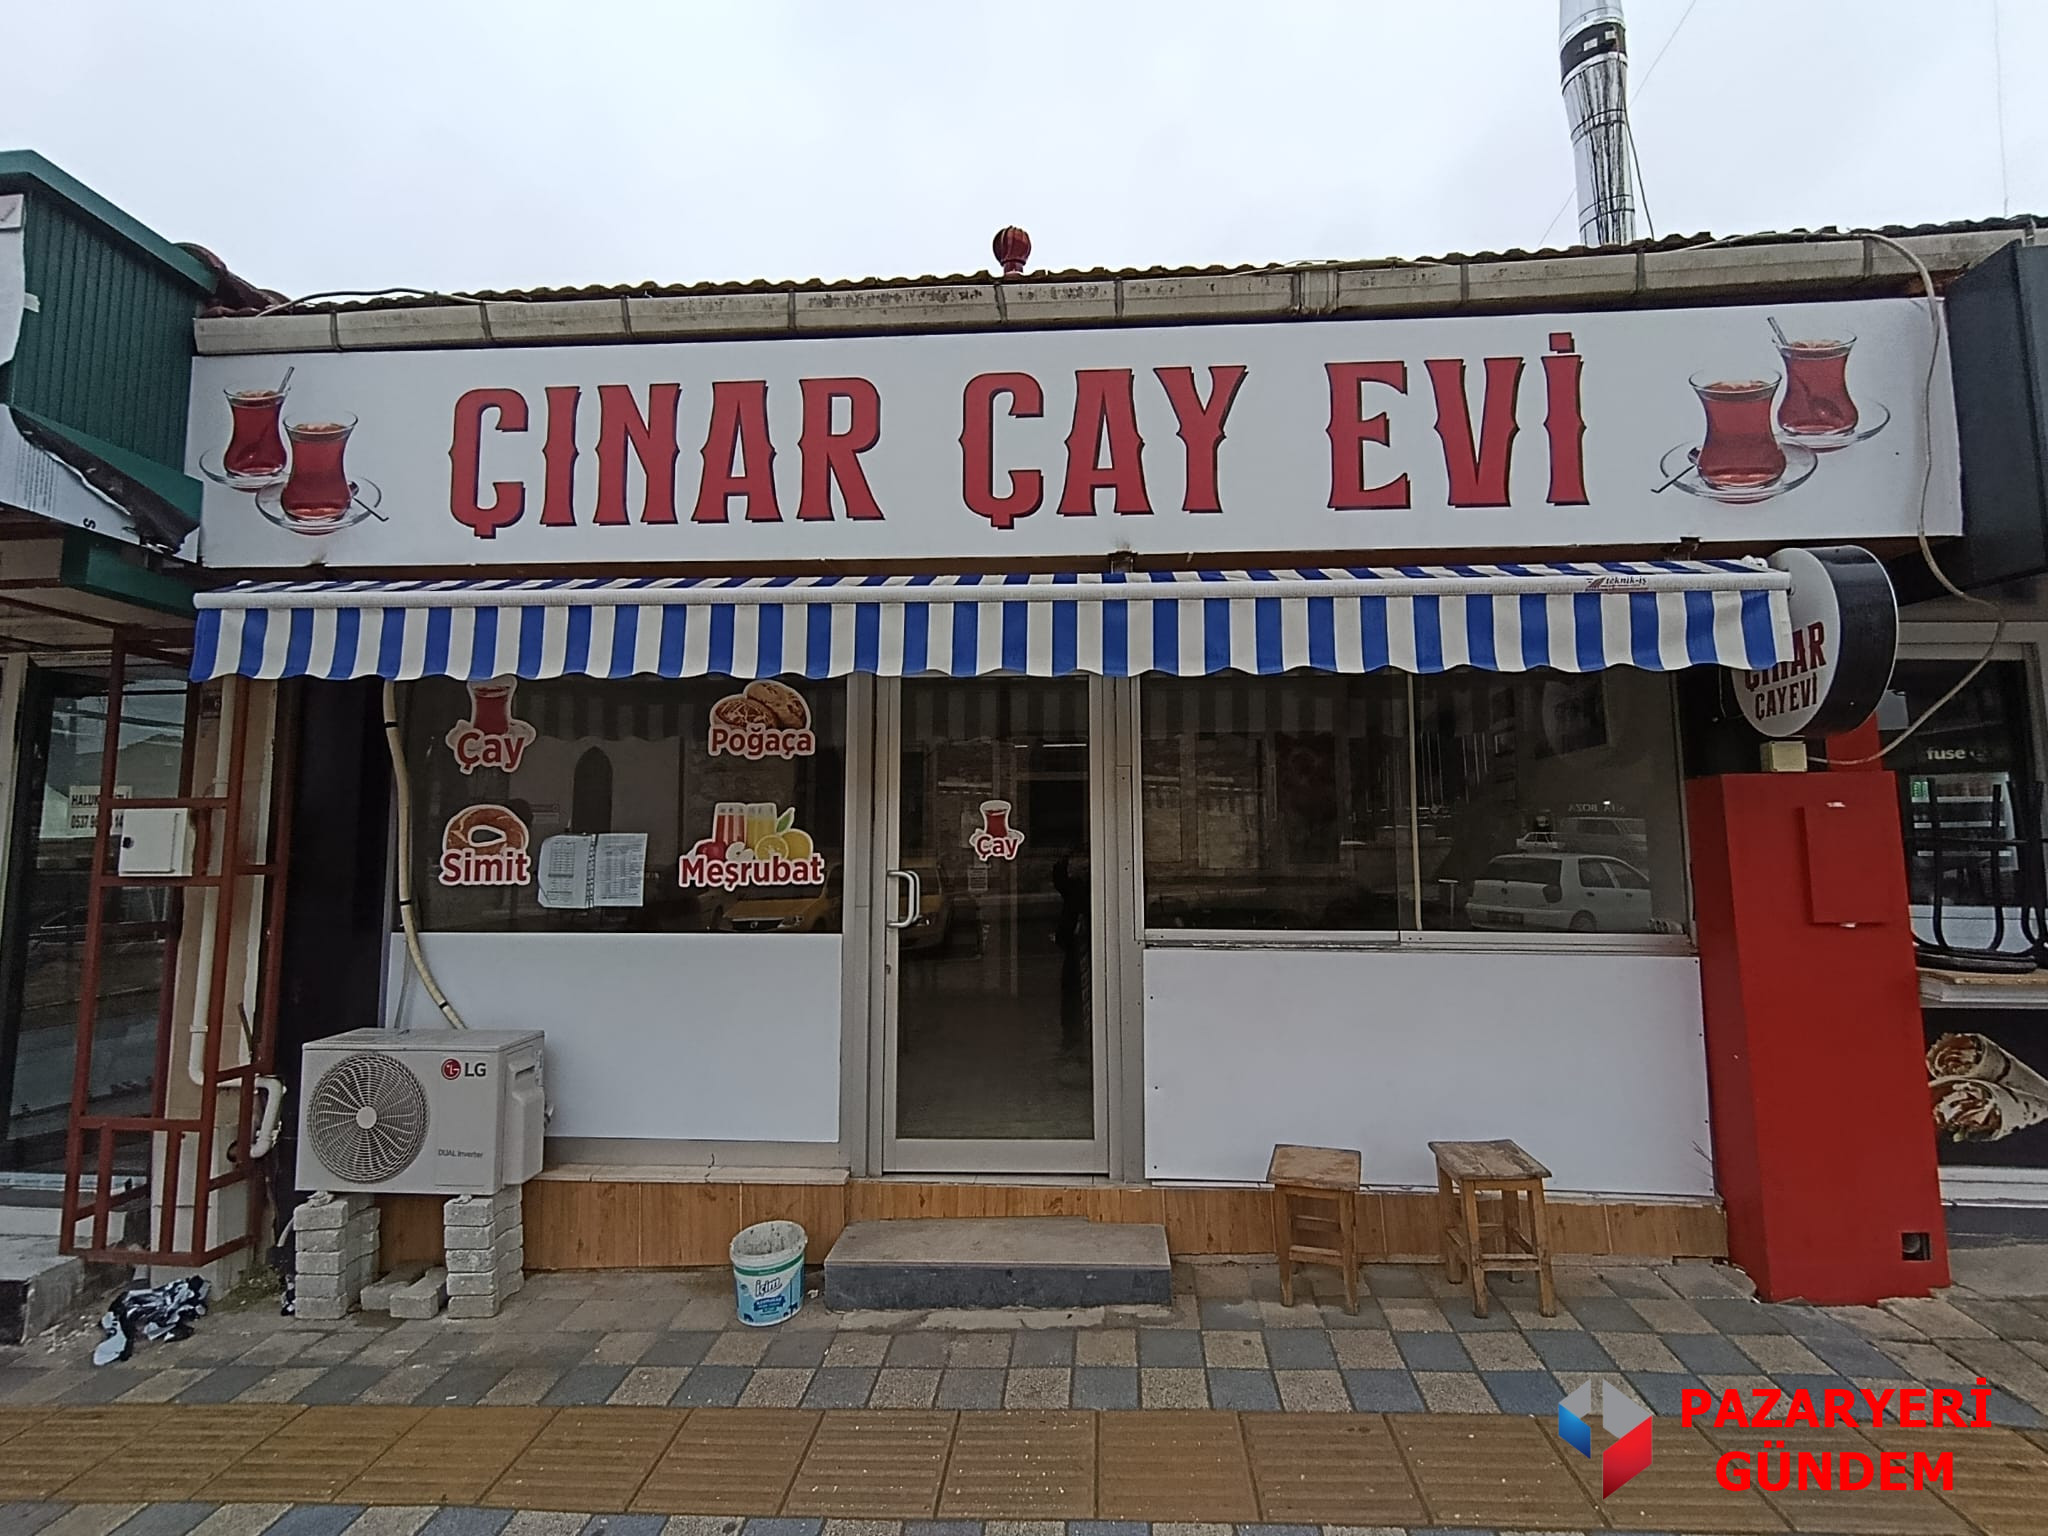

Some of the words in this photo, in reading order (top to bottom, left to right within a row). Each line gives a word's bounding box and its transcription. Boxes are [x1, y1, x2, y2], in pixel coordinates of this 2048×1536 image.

[448, 376, 885, 539] ÇINAR
[958, 365, 1248, 530] ÇAY
[1325, 331, 1591, 511] EVİ
[457, 731, 525, 771] Çay
[710, 727, 812, 756] Poğaça
[976, 835, 1019, 859] Çay
[442, 851, 528, 882] Simit
[681, 855, 823, 888] Meşrubat
[464, 1062, 487, 1077] LG
